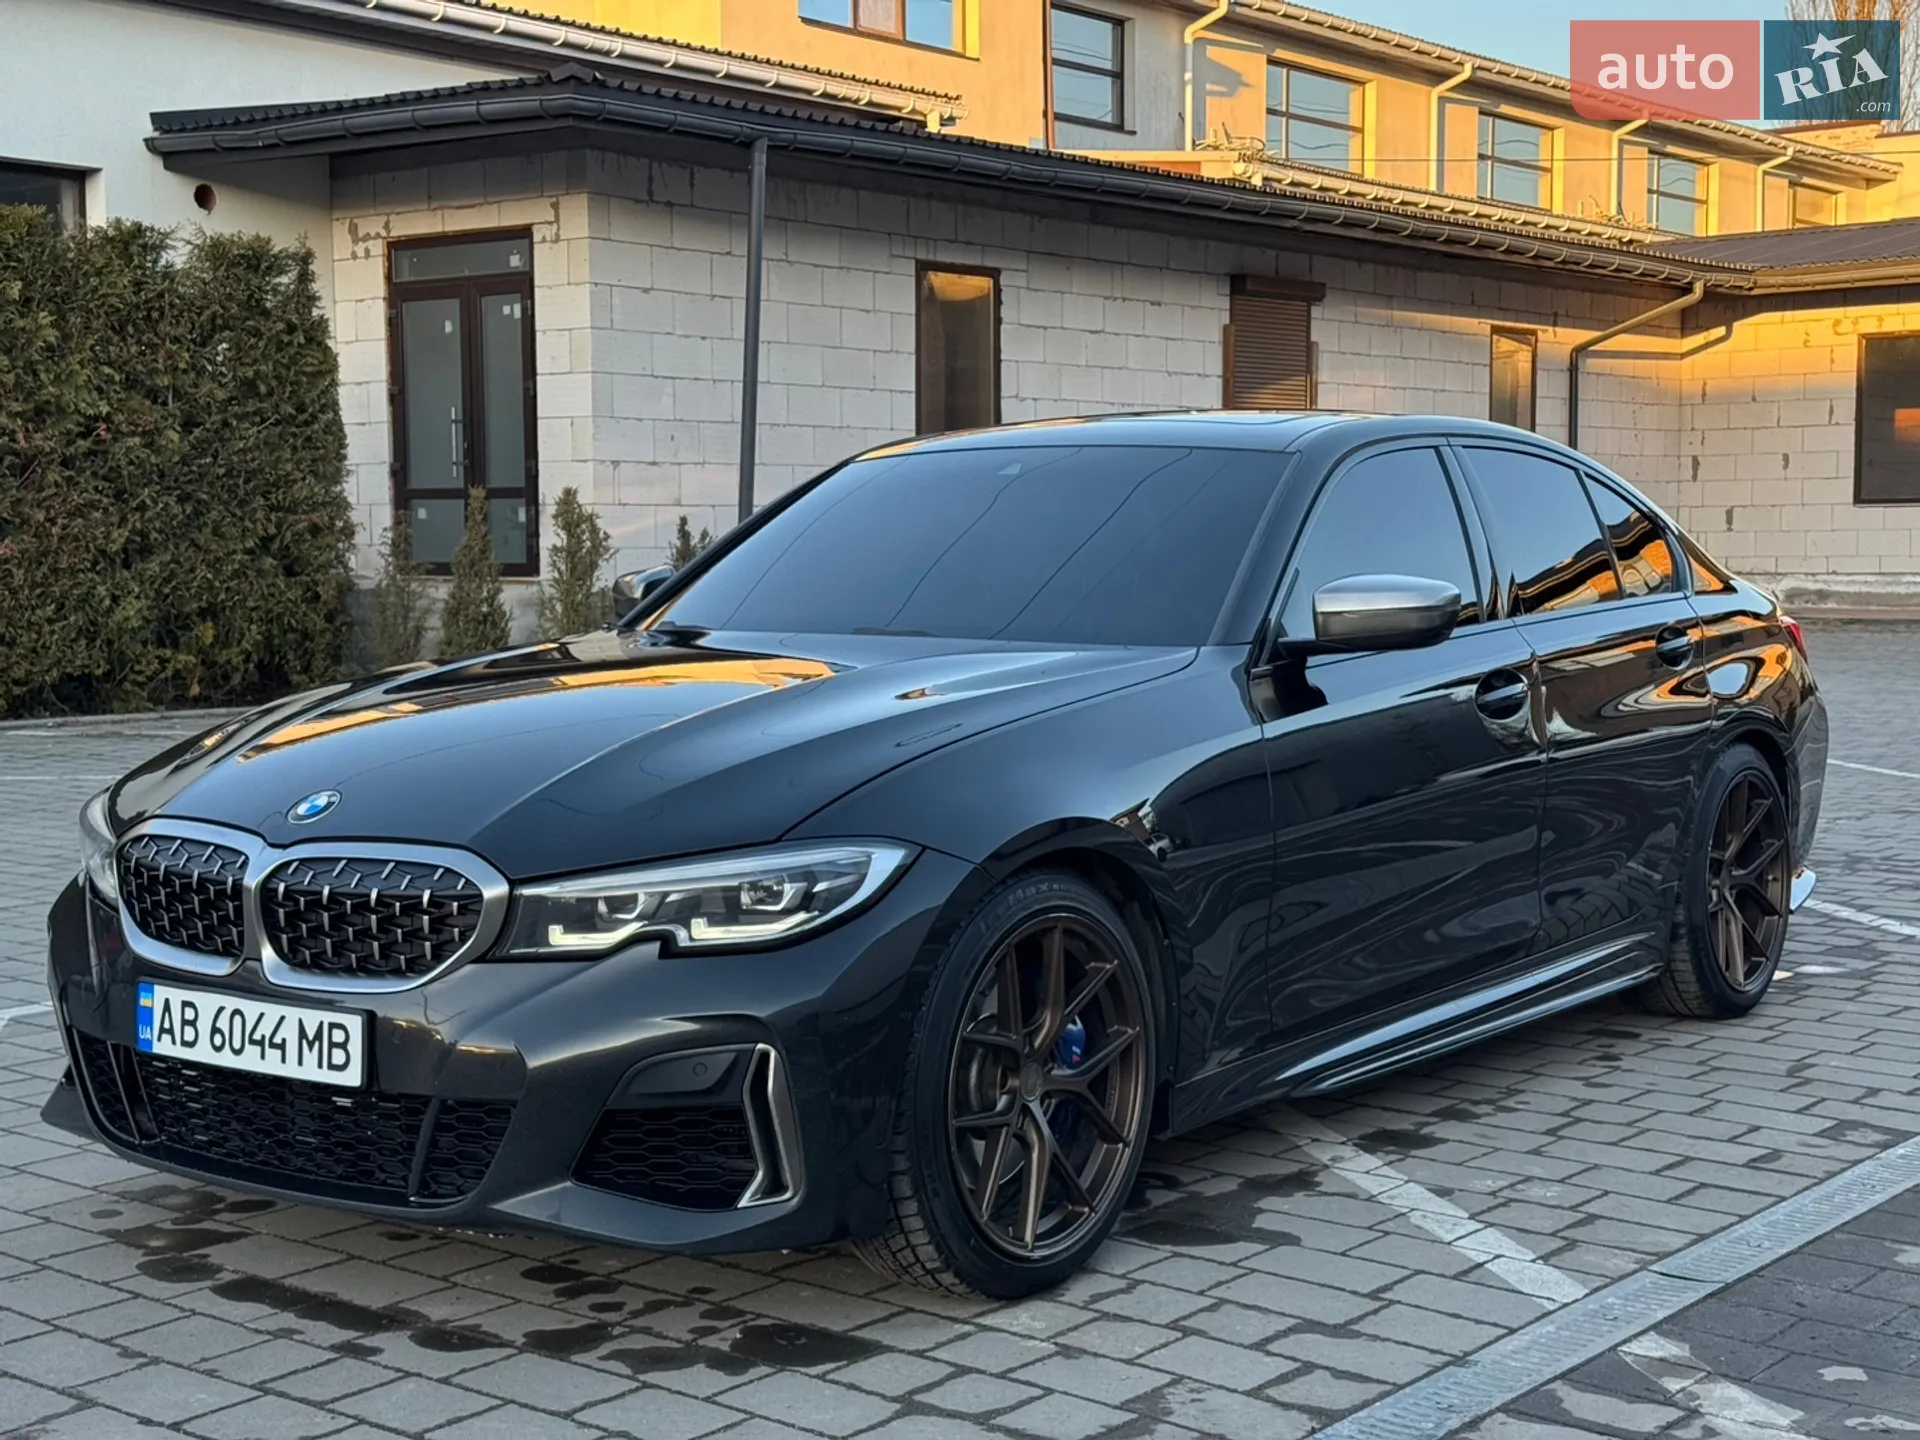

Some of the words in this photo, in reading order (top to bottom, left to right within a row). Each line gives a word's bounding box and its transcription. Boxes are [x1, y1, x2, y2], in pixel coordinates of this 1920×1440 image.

[139, 1024, 152, 1040] UA
[157, 997, 200, 1049] AB
[210, 1005, 287, 1064] 6044
[298, 1017, 351, 1072] MB
